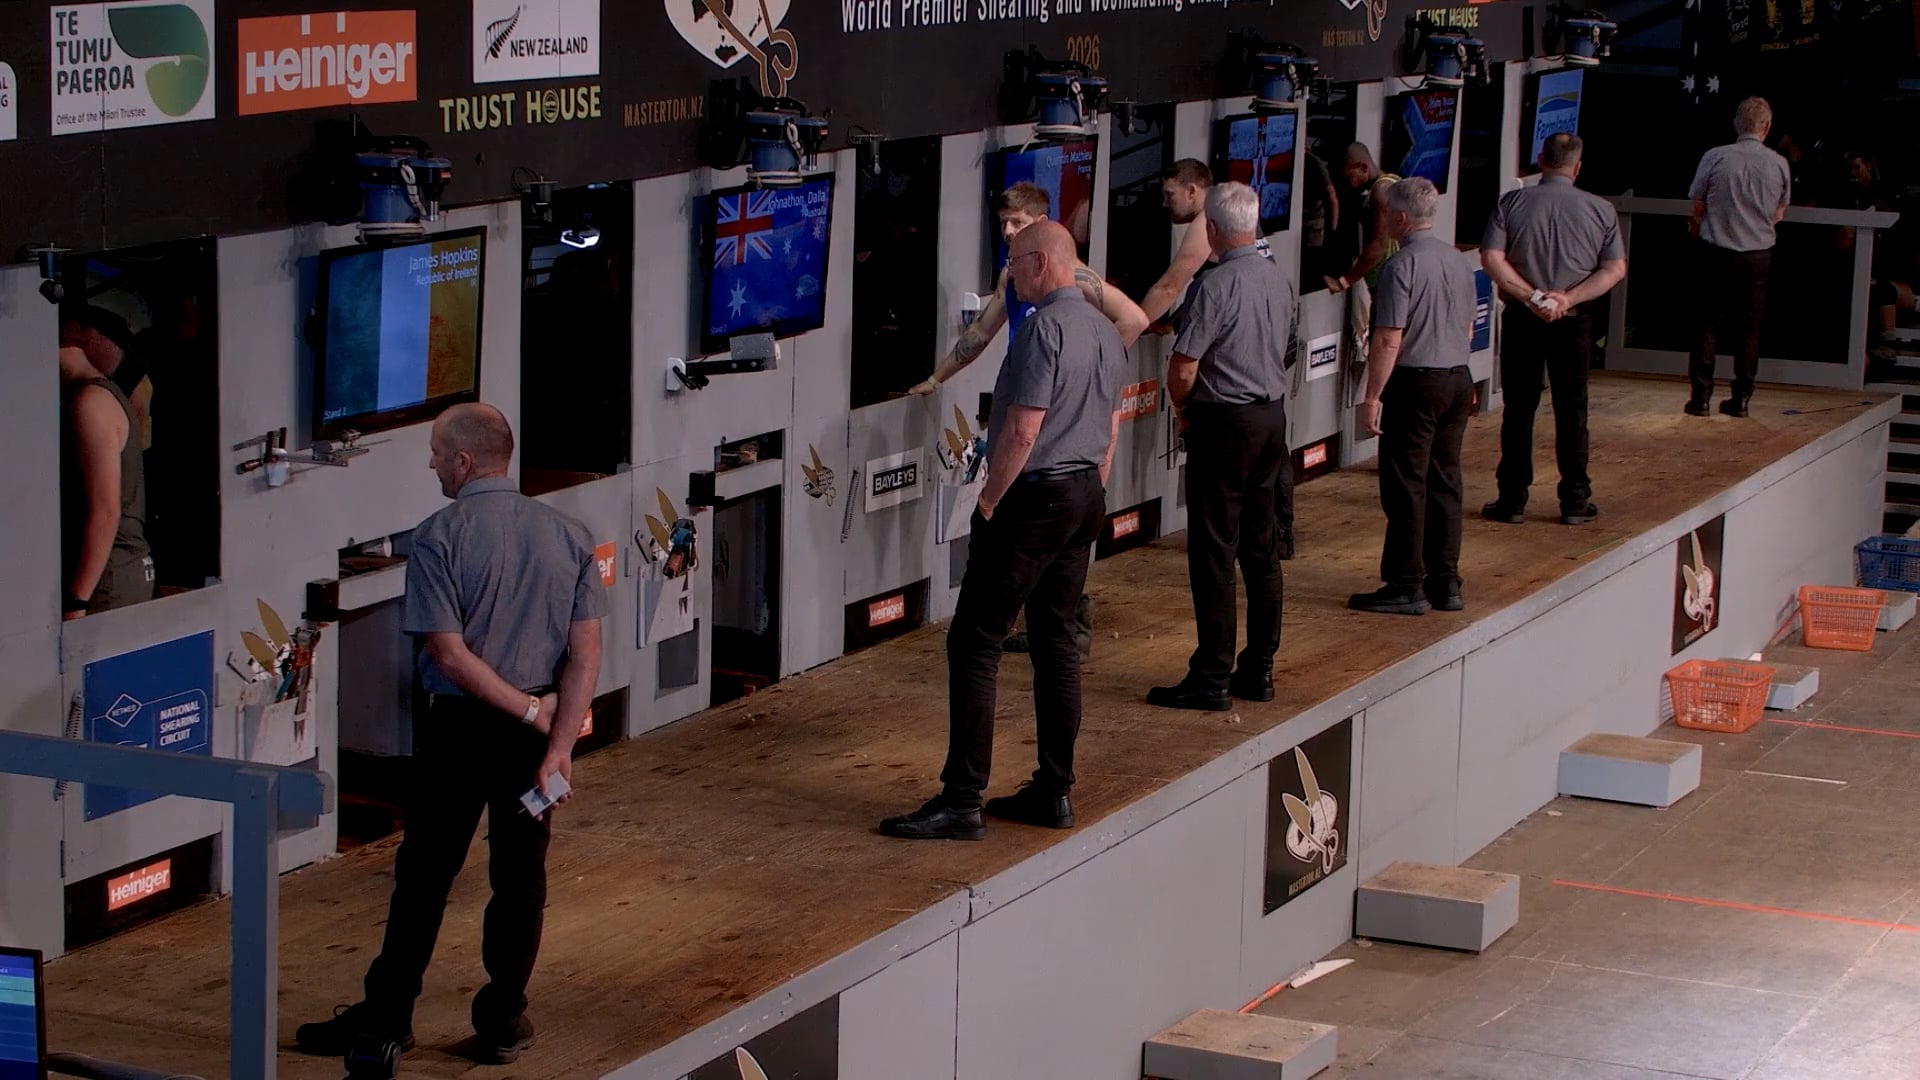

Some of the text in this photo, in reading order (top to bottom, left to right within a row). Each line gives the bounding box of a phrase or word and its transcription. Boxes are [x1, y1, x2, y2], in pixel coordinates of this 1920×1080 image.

[55, 11, 79, 37] TE
[900, 0, 968, 28] Premier
[1416, 7, 1479, 28] TUST HOUSE
[56, 38, 113, 66] TUMU
[246, 12, 413, 99] Heiniger
[510, 36, 588, 57] NEW ZEALAND
[1067, 34, 1100, 71] 2026
[57, 65, 135, 96] PAEROA
[56, 112, 76, 126] Office
[78, 112, 86, 122] of
[86, 110, 98, 121] the
[120, 107, 147, 119] Trustee
[439, 85, 602, 133] TRUST HOUSE
[624, 96, 705, 129] MASTERTON.NZ
[1536, 112, 1577, 141] Farmlands
[768, 189, 826, 212] Johnathon Dalla
[409, 247, 478, 274] James Hopkins
[415, 265, 478, 286] Republic of Ireland
[1120, 383, 1157, 414] einiger
[875, 468, 914, 491] BAYLEYS
[160, 700, 200, 720] NATIONAL
[160, 712, 201, 733] SHEARING
[160, 728, 192, 746] CIRCUIT
[111, 867, 170, 903] Heiniger
